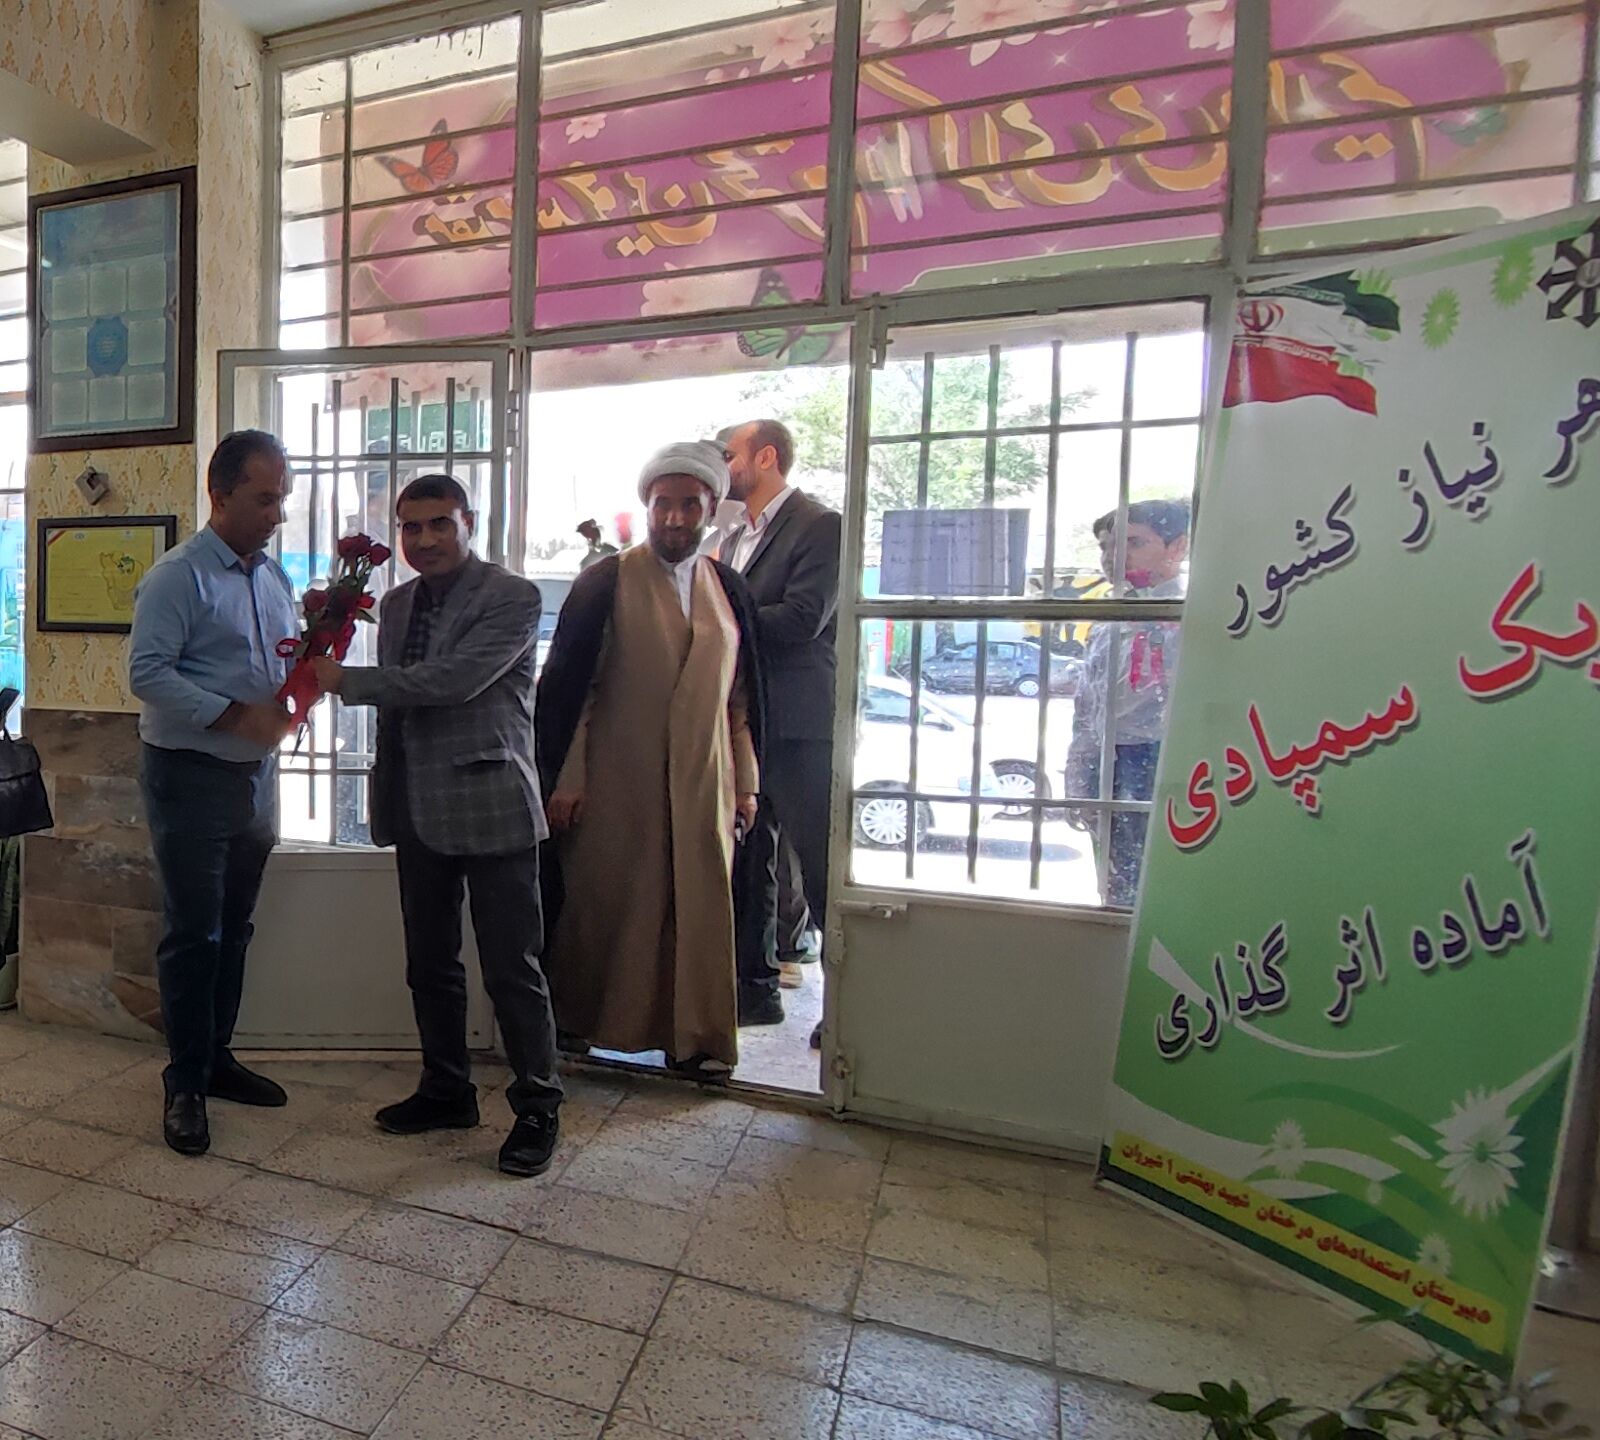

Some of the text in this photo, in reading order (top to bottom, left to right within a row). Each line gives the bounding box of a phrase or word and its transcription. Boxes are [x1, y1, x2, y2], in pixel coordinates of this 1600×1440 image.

[1399, 421, 1498, 544] نیاز
[1226, 483, 1355, 632] کشور
[1166, 685, 1416, 846] سمپادی
[1156, 830, 1549, 1056] آماده اثر گذاری
[1122, 1143, 1164, 1169] شیروان
[1175, 1170, 1216, 1197] بهشتی
[1217, 1186, 1250, 1209] شهید
[1256, 1205, 1314, 1240] درخشان
[1316, 1235, 1411, 1284] استعدادهای
[1412, 1279, 1492, 1326] دبیرستان
